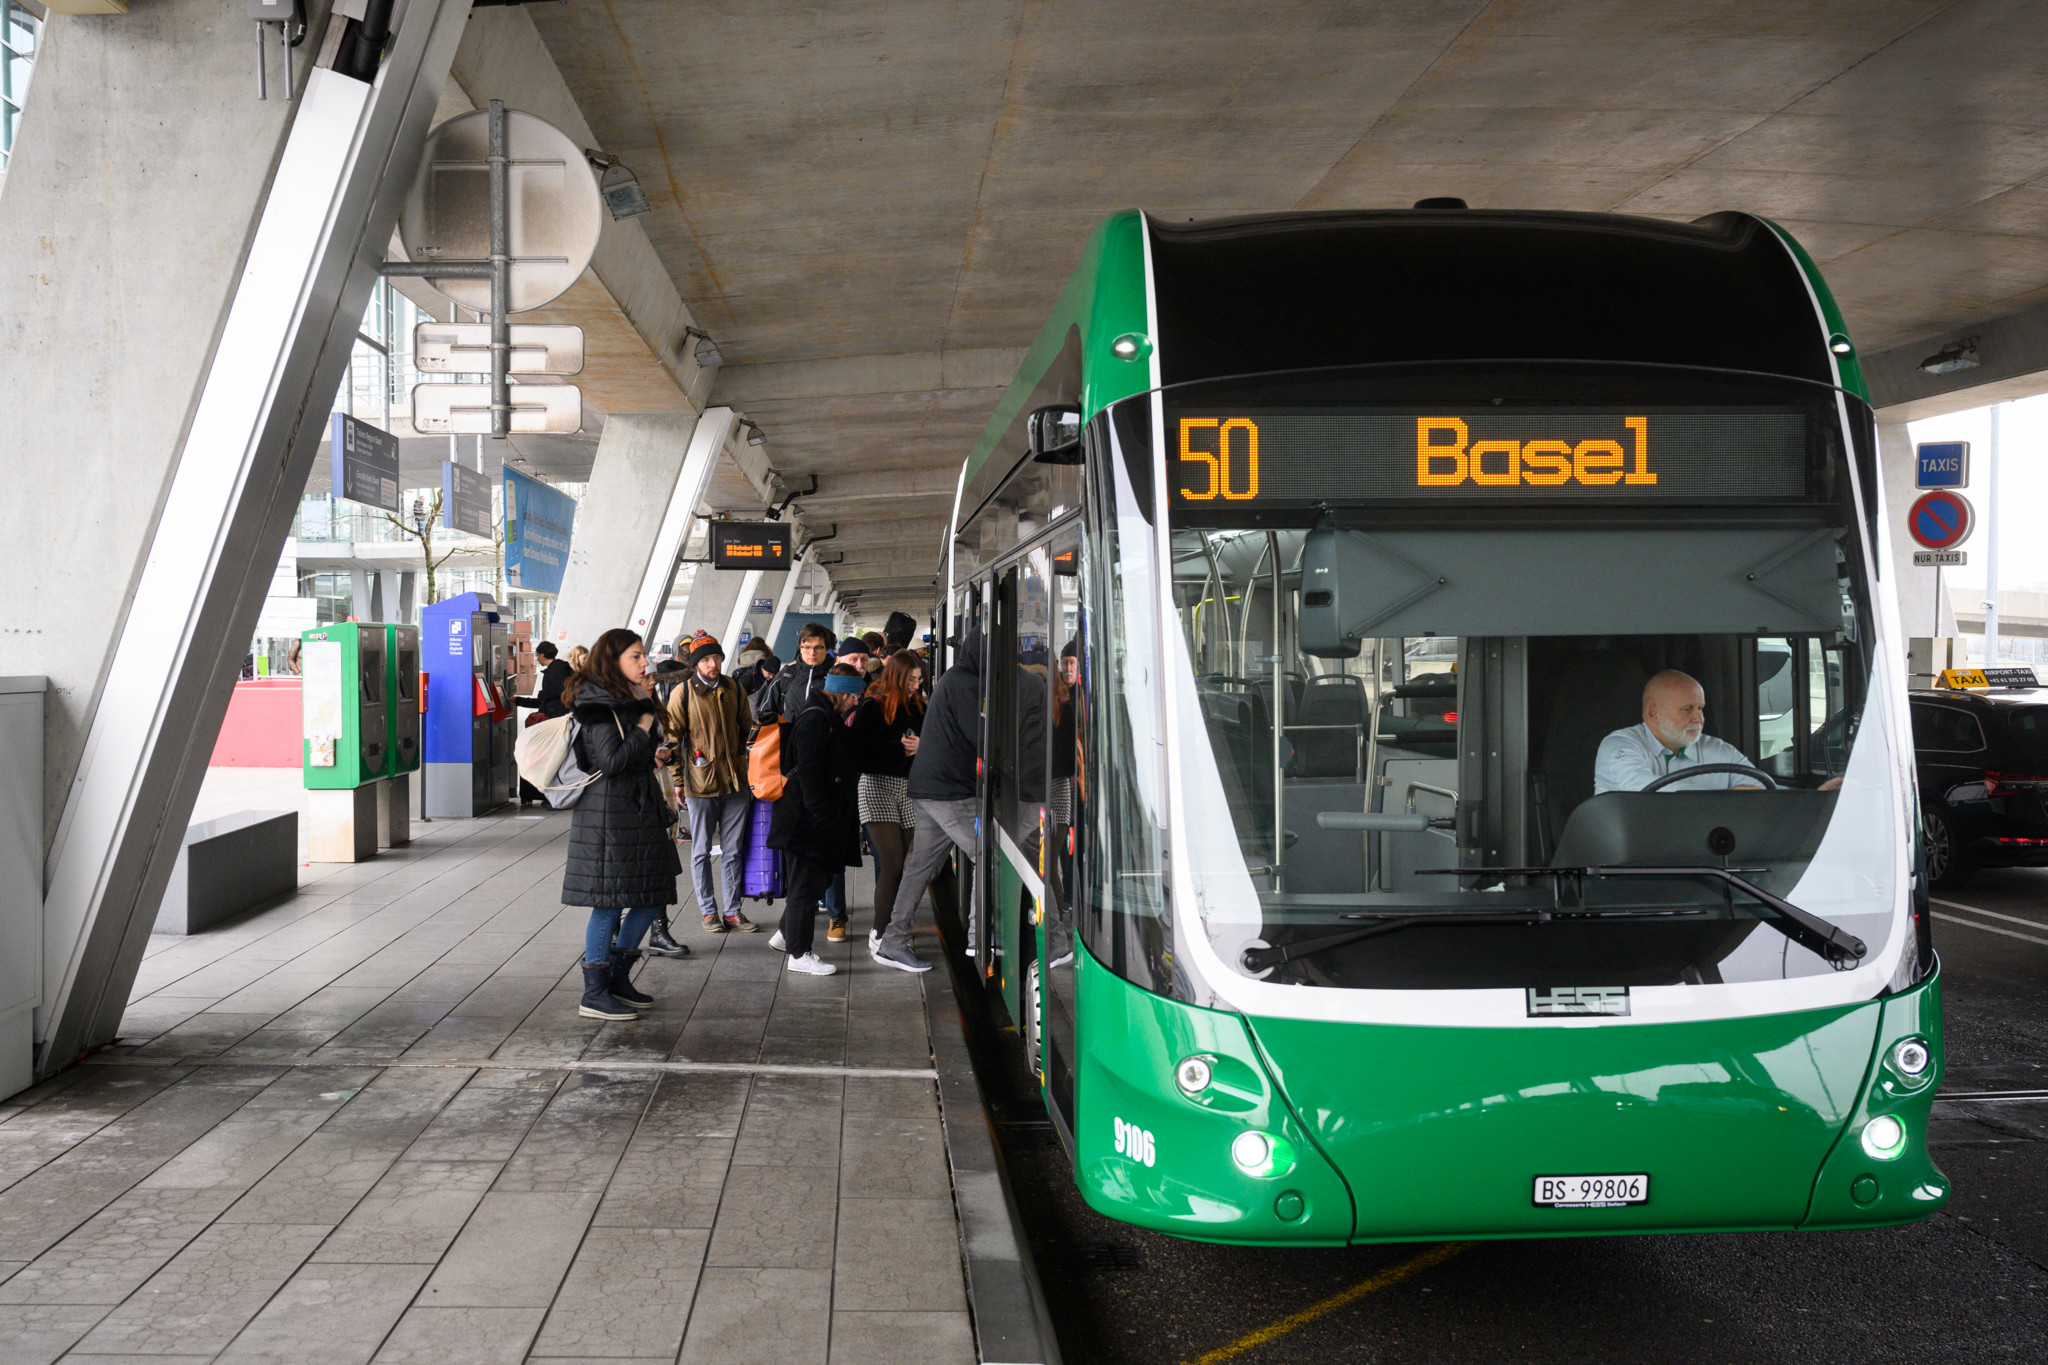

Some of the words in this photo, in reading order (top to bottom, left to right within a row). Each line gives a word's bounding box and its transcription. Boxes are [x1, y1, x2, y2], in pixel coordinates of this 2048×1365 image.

[1180, 418, 1259, 500] 50
[1416, 416, 1657, 486] Basel
[1921, 457, 1959, 473] TAXIS
[1914, 554, 1931, 564] NUR
[1935, 552, 1960, 563] TAXIS
[1951, 675, 1984, 685] TAXI
[1113, 1116, 1156, 1168] 9106
